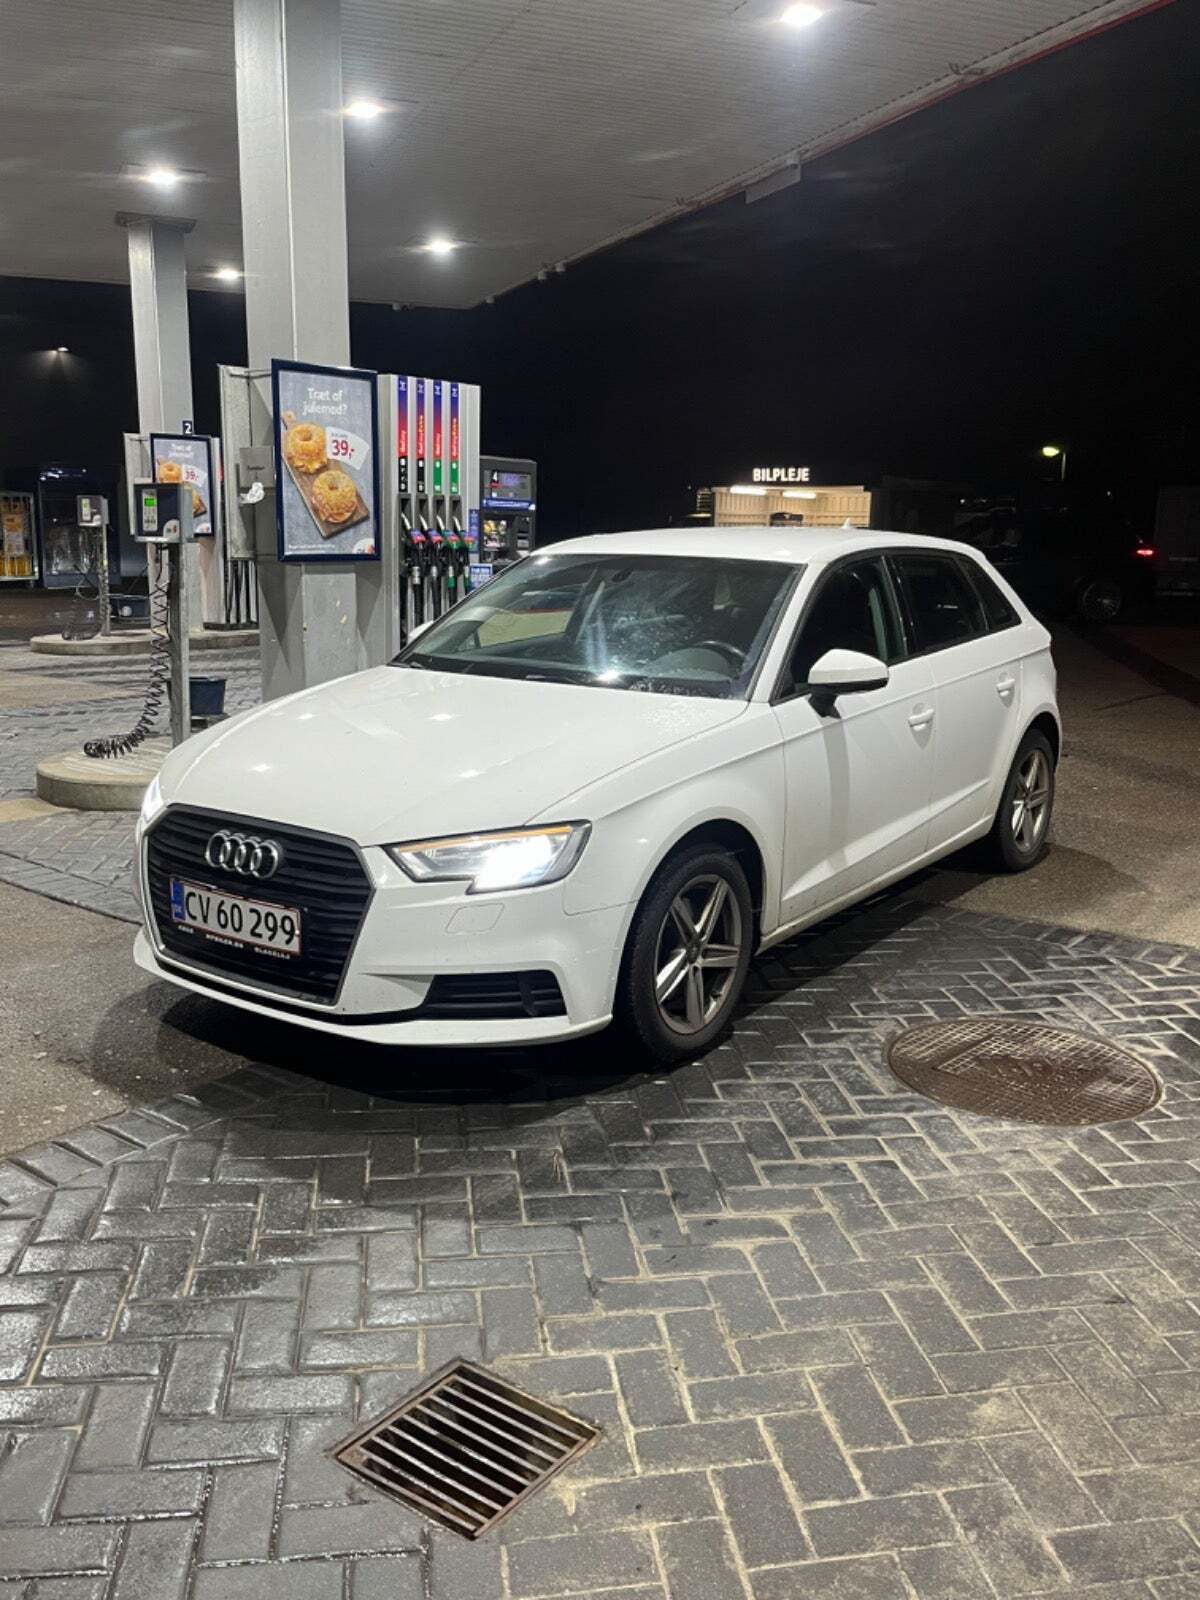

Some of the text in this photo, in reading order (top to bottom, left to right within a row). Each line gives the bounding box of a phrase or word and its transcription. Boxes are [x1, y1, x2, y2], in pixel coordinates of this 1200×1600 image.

[185, 423, 192, 434] 2
[331, 439, 355, 459] 39,-
[752, 467, 810, 482] BILPLEJE
[185, 891, 210, 924] CV
[217, 900, 243, 932] 60
[249, 908, 295, 945] 299
